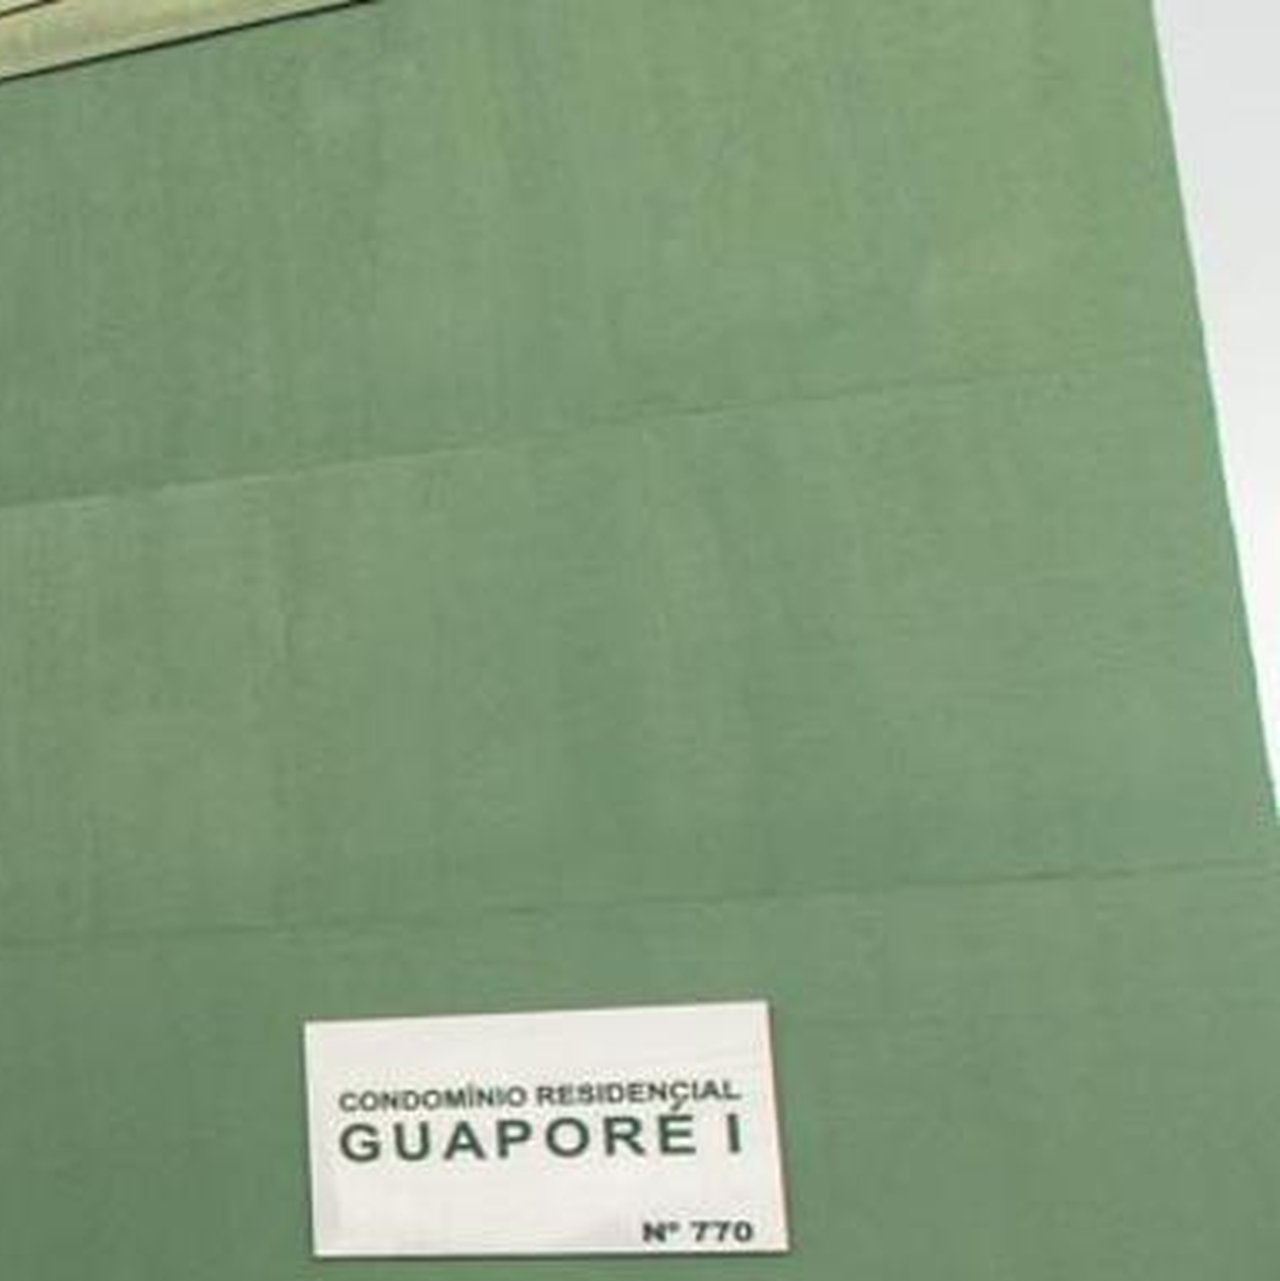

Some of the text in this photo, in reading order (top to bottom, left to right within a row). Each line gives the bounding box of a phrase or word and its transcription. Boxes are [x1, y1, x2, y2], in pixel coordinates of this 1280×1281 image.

[339, 1080, 742, 1112] CONDOMÍNIO RESIDENCIAL
[339, 1101, 742, 1163] GUAPORÉ I
[690, 1220, 754, 1243] 770
